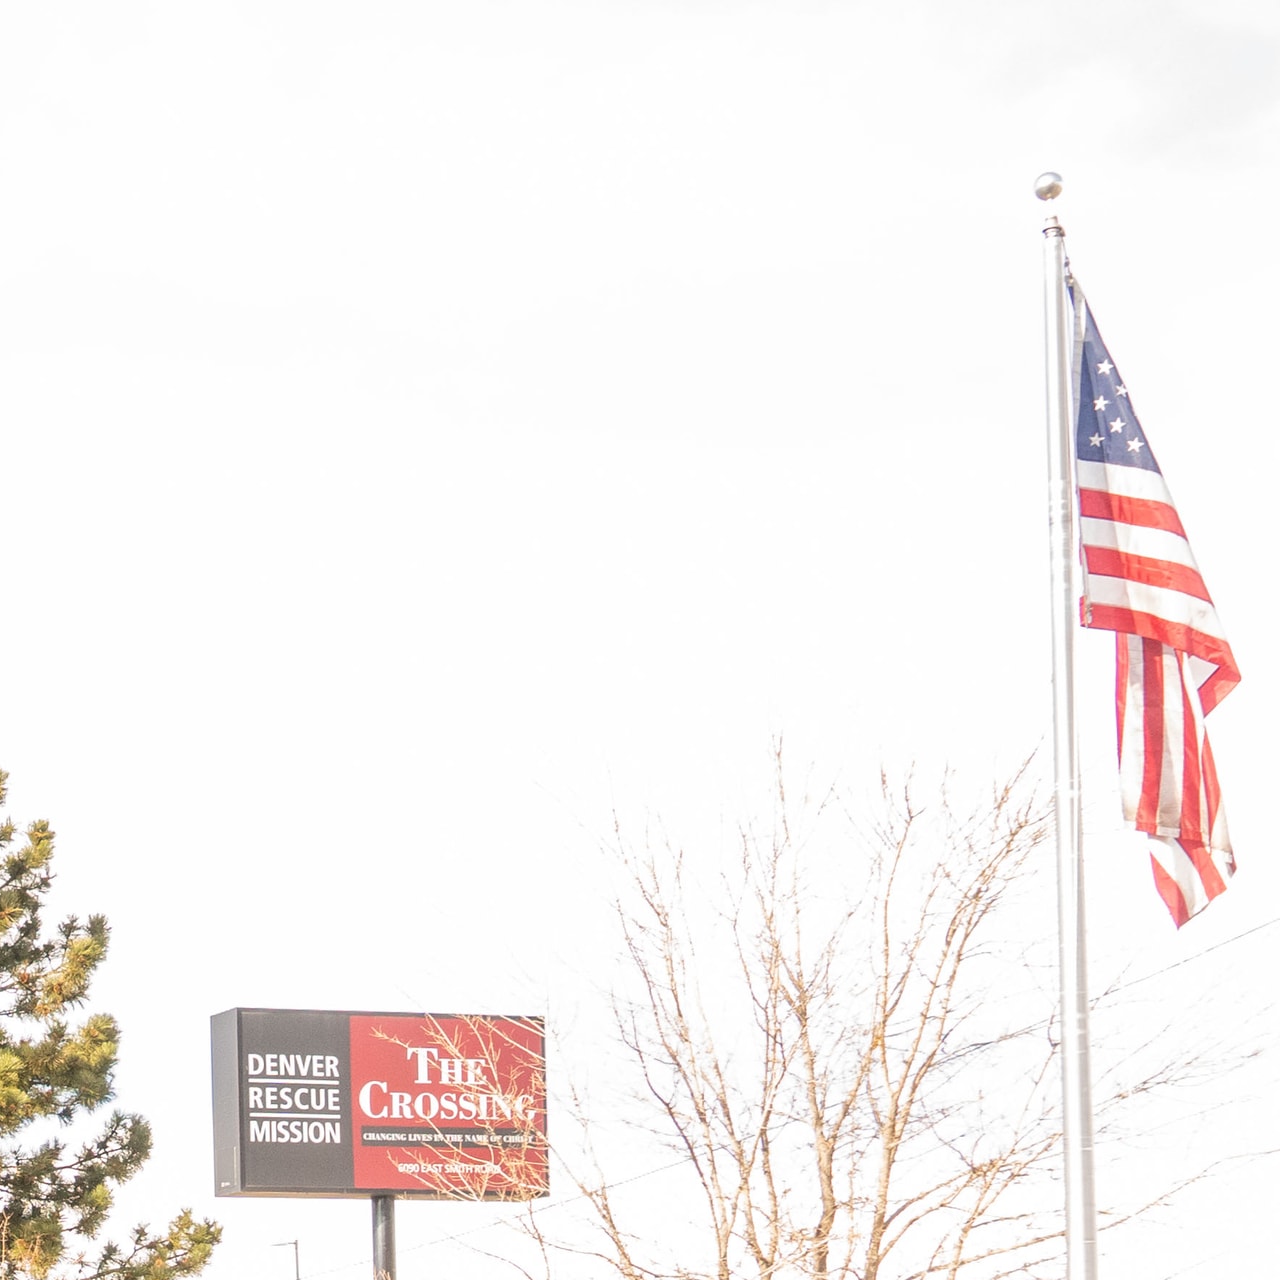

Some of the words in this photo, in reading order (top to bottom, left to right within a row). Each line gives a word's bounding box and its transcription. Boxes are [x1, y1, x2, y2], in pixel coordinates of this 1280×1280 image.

[247, 1053, 340, 1077] DENVER
[406, 1047, 487, 1085] THE
[248, 1086, 341, 1111] RESCUE
[358, 1080, 538, 1121] CROSSING
[249, 1120, 341, 1144] MISSION
[363, 1132, 407, 1142] CHANGING
[408, 1133, 433, 1142] LIVES
[445, 1134, 464, 1142] THE
[465, 1134, 489, 1143] NAME
[398, 1163, 420, 1173] 6090
[421, 1163, 443, 1173] EAST
